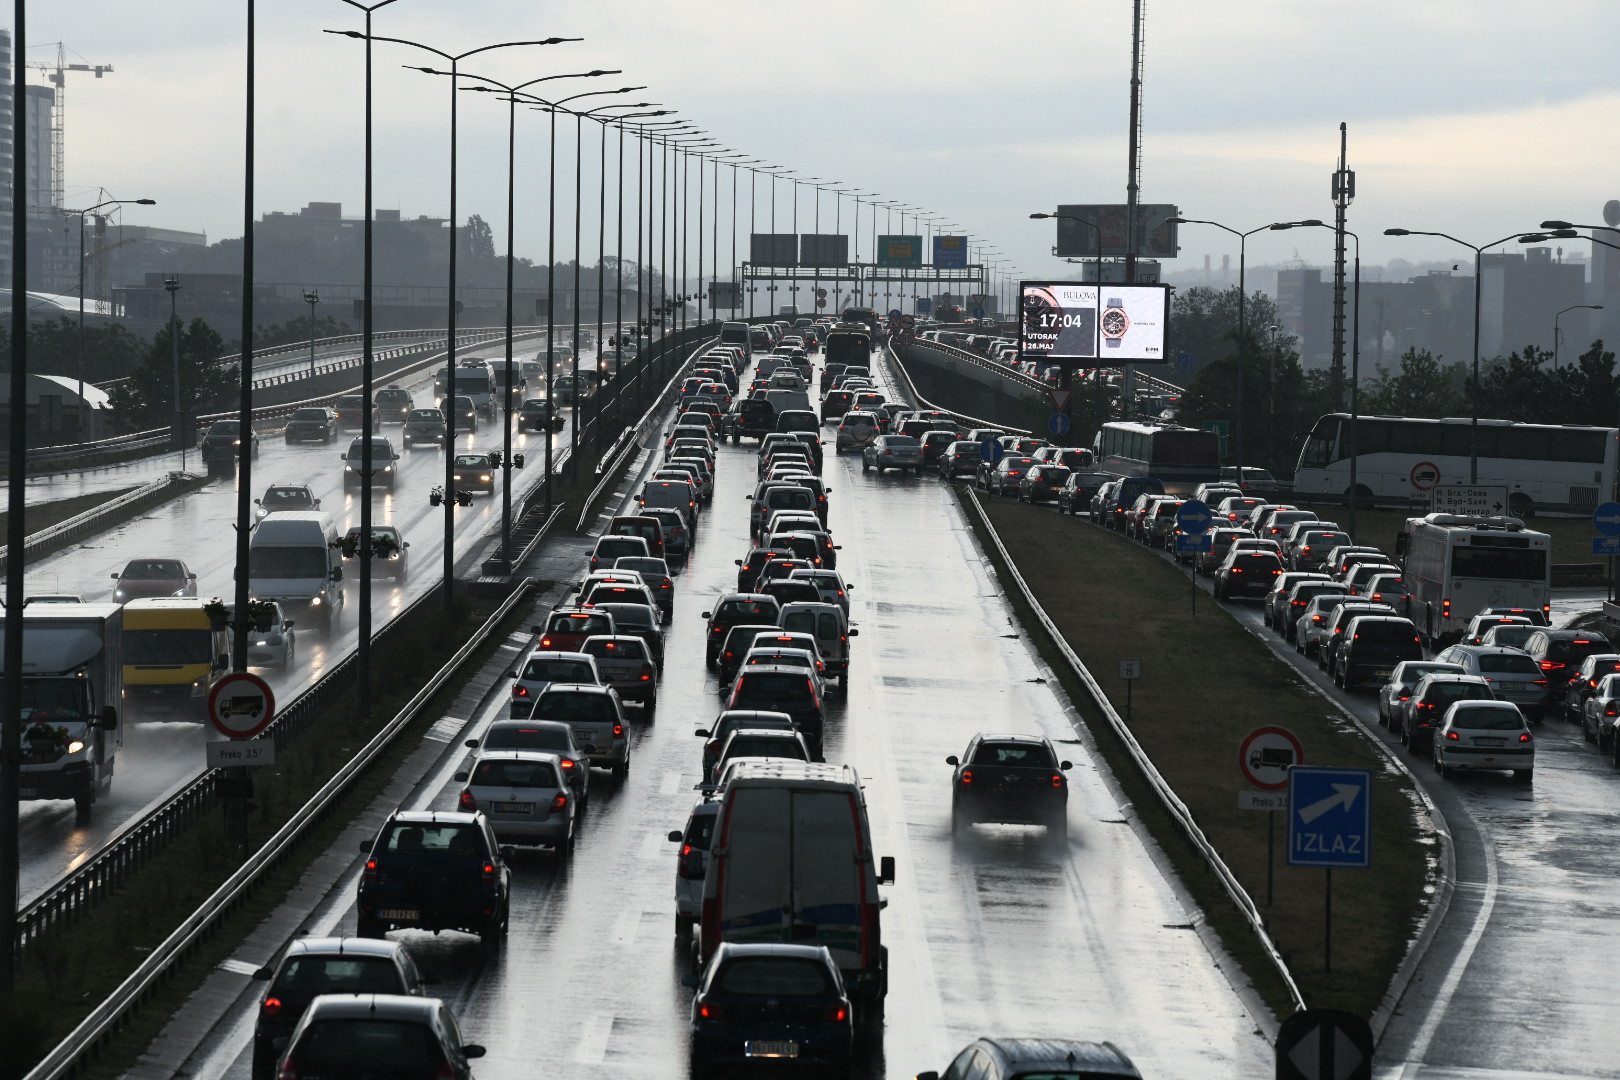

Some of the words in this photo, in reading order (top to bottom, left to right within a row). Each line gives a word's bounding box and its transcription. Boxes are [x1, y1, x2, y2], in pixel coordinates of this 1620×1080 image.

[1063, 291, 1096, 300] BULOVA
[1040, 313, 1081, 328] 17:04
[1447, 498, 1487, 506] Bgd-Sava
[220, 749, 241, 759] Preko
[1252, 796, 1273, 807] Preko
[1296, 832, 1361, 854] IZLAZ
